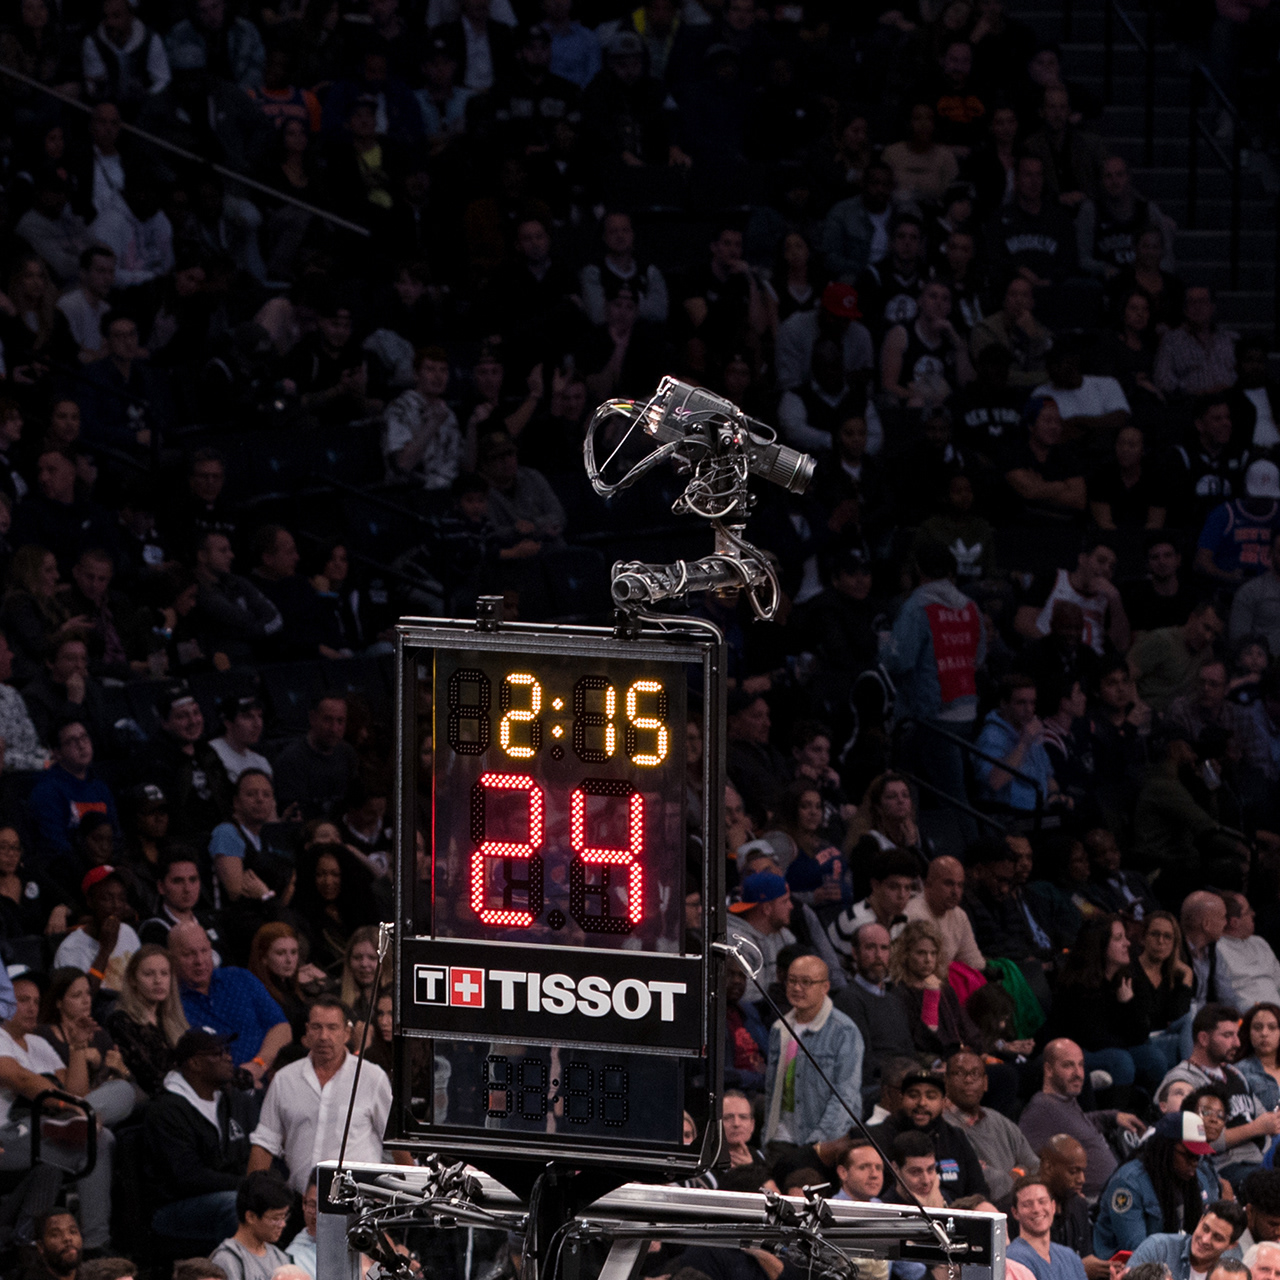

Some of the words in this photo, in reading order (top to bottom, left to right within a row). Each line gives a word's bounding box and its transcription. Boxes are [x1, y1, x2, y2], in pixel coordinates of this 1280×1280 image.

[498, 672, 668, 766] 2:15
[470, 771, 646, 929] 24
[489, 969, 687, 1022] TISSOT
